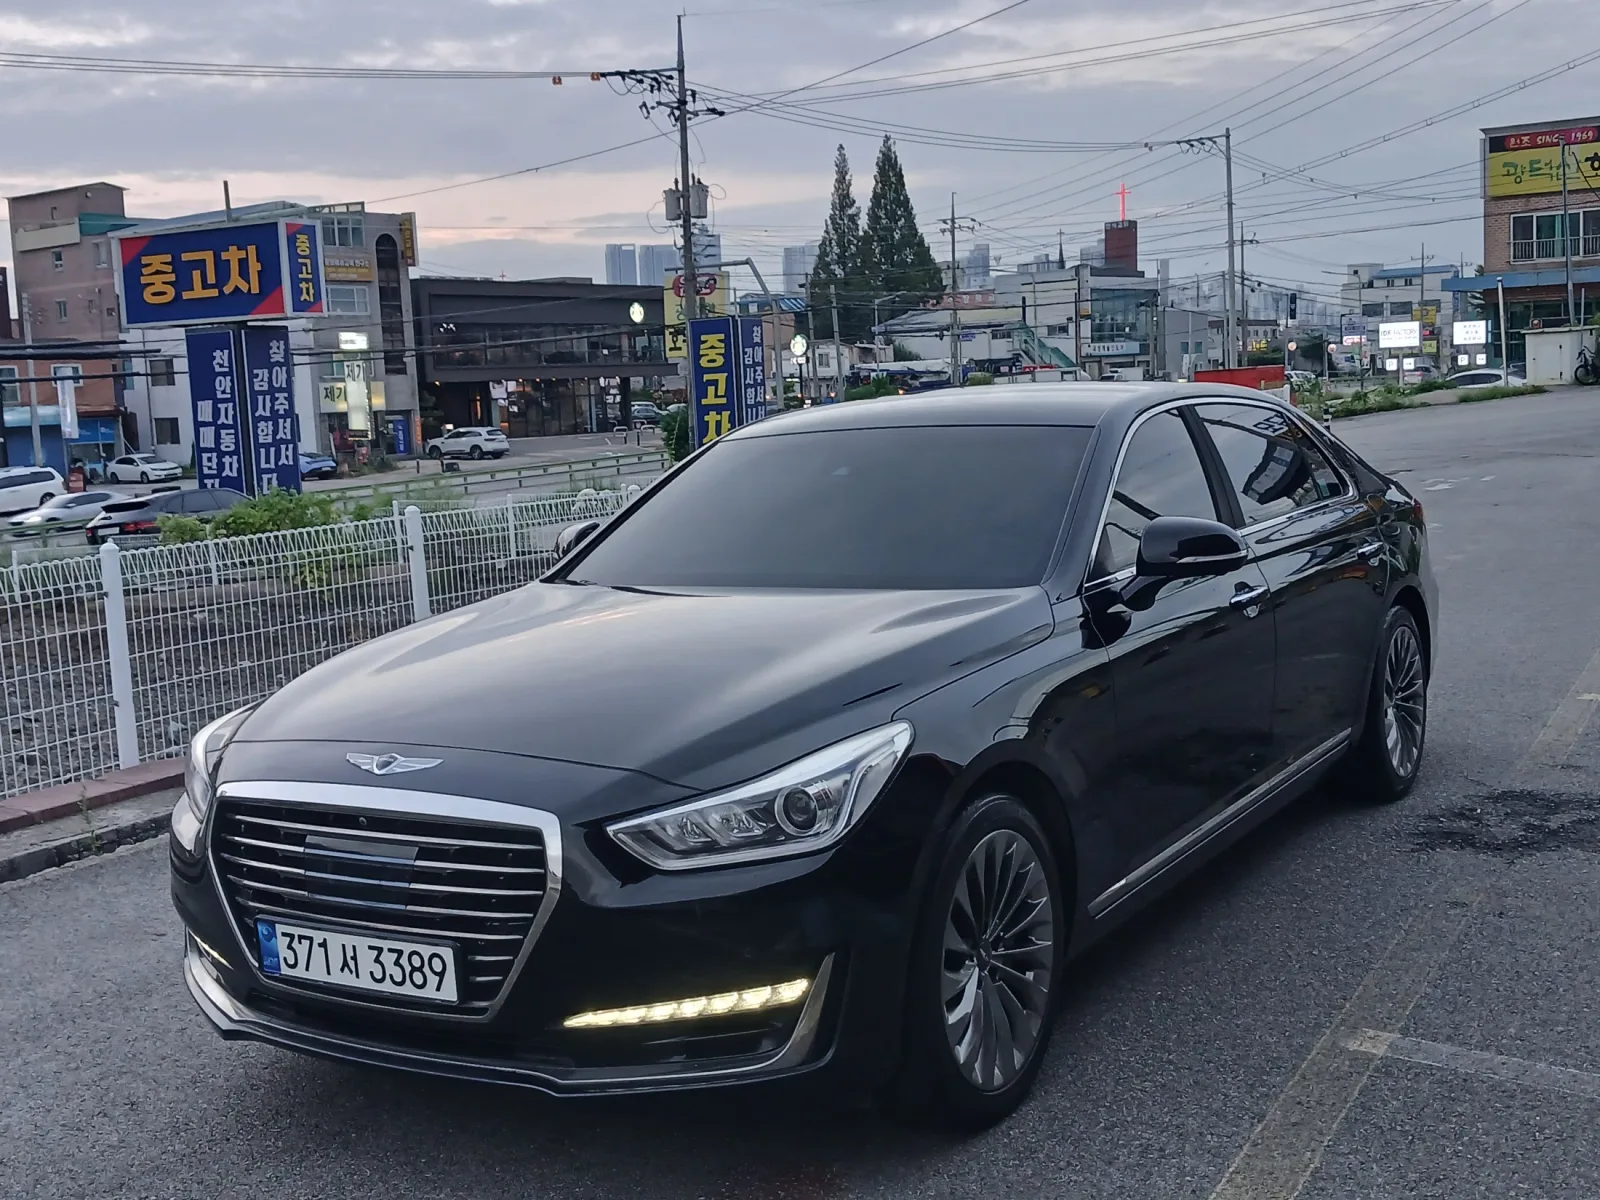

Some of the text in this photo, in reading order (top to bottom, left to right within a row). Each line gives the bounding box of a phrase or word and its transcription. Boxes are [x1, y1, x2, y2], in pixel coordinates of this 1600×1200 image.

[1571, 130, 1594, 142] 1969
[140, 244, 262, 305] 중고차
[295, 234, 315, 303] 중고차
[212, 349, 239, 478] 천안자동차
[253, 368, 279, 495] 감사합니다
[269, 340, 294, 466] 찾아주셔서
[699, 333, 732, 444] 중고차
